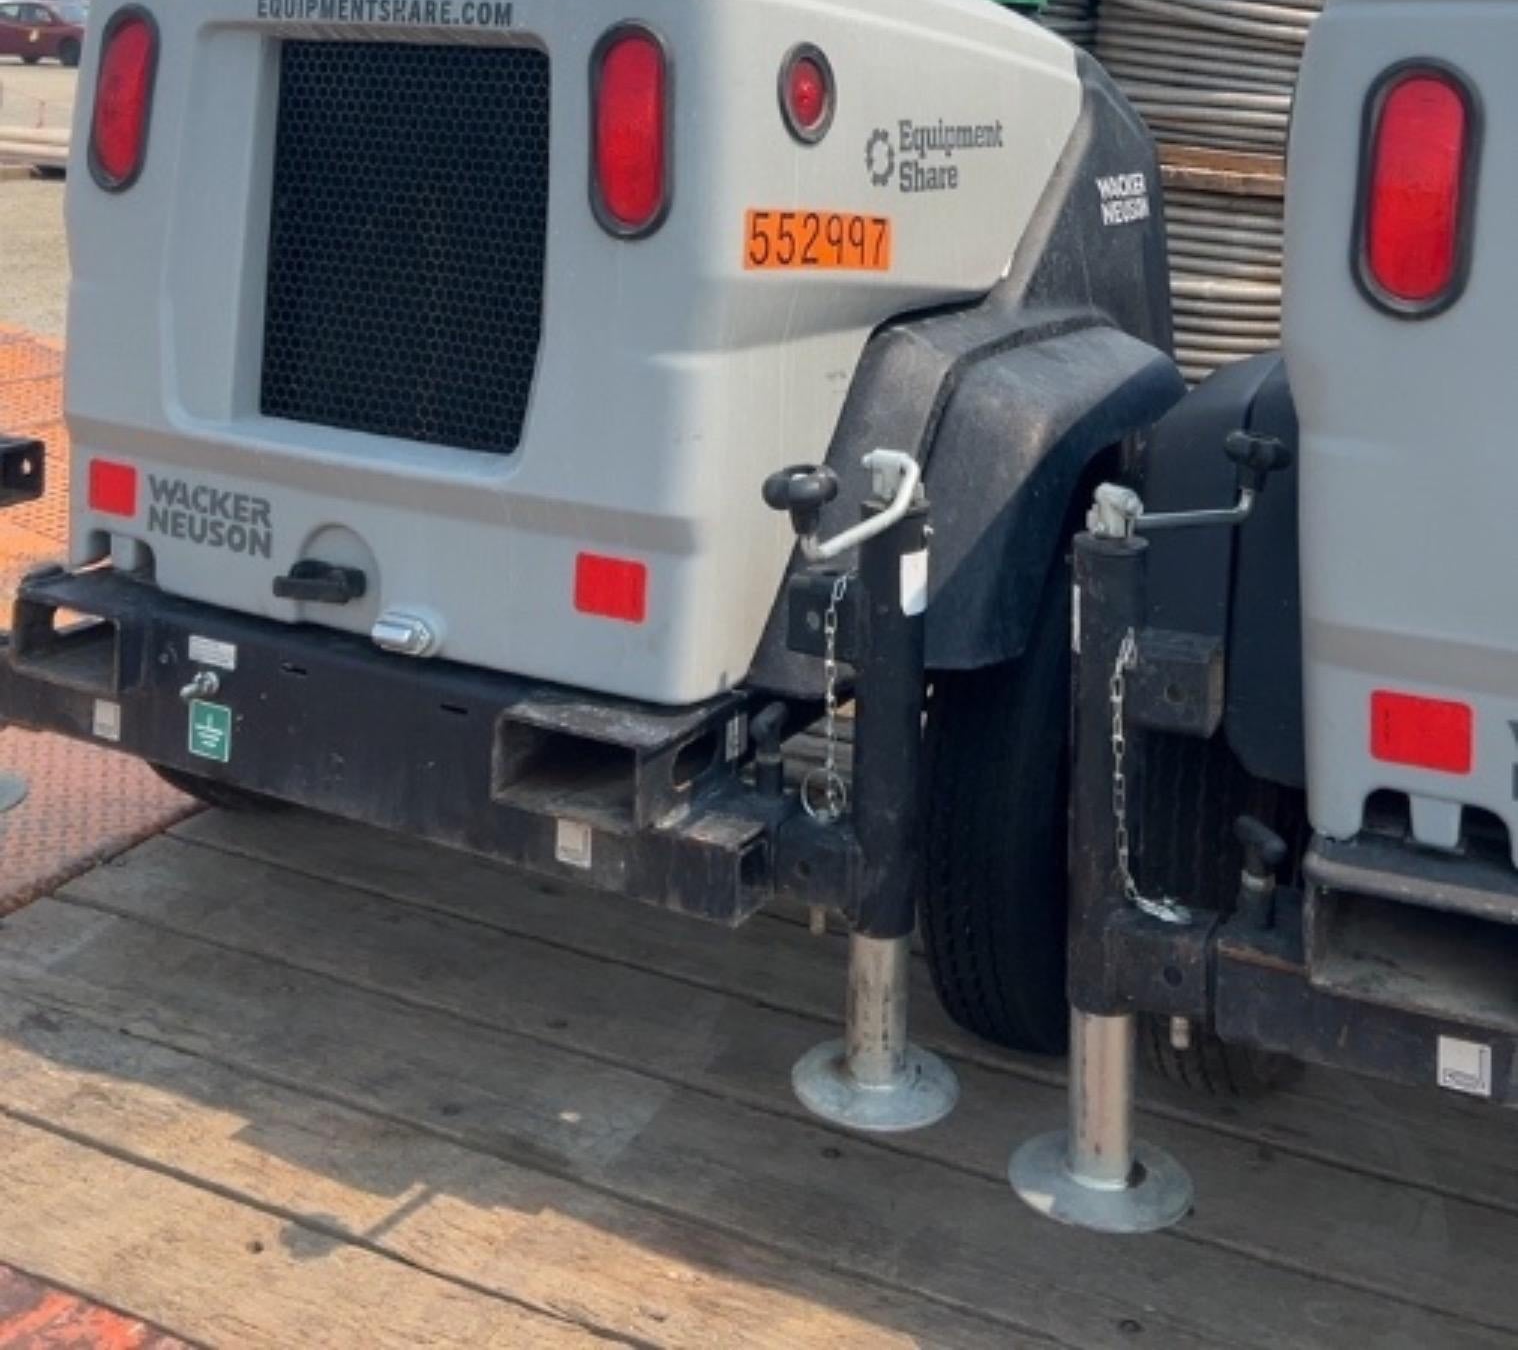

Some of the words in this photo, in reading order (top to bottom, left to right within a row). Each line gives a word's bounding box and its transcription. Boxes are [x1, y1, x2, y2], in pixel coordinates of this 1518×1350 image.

[898, 118, 1003, 158] Equipment
[899, 160, 958, 193] Share
[749, 212, 888, 265] 552997
[147, 473, 272, 531] WACKER
[147, 503, 272, 560] NEUSON
